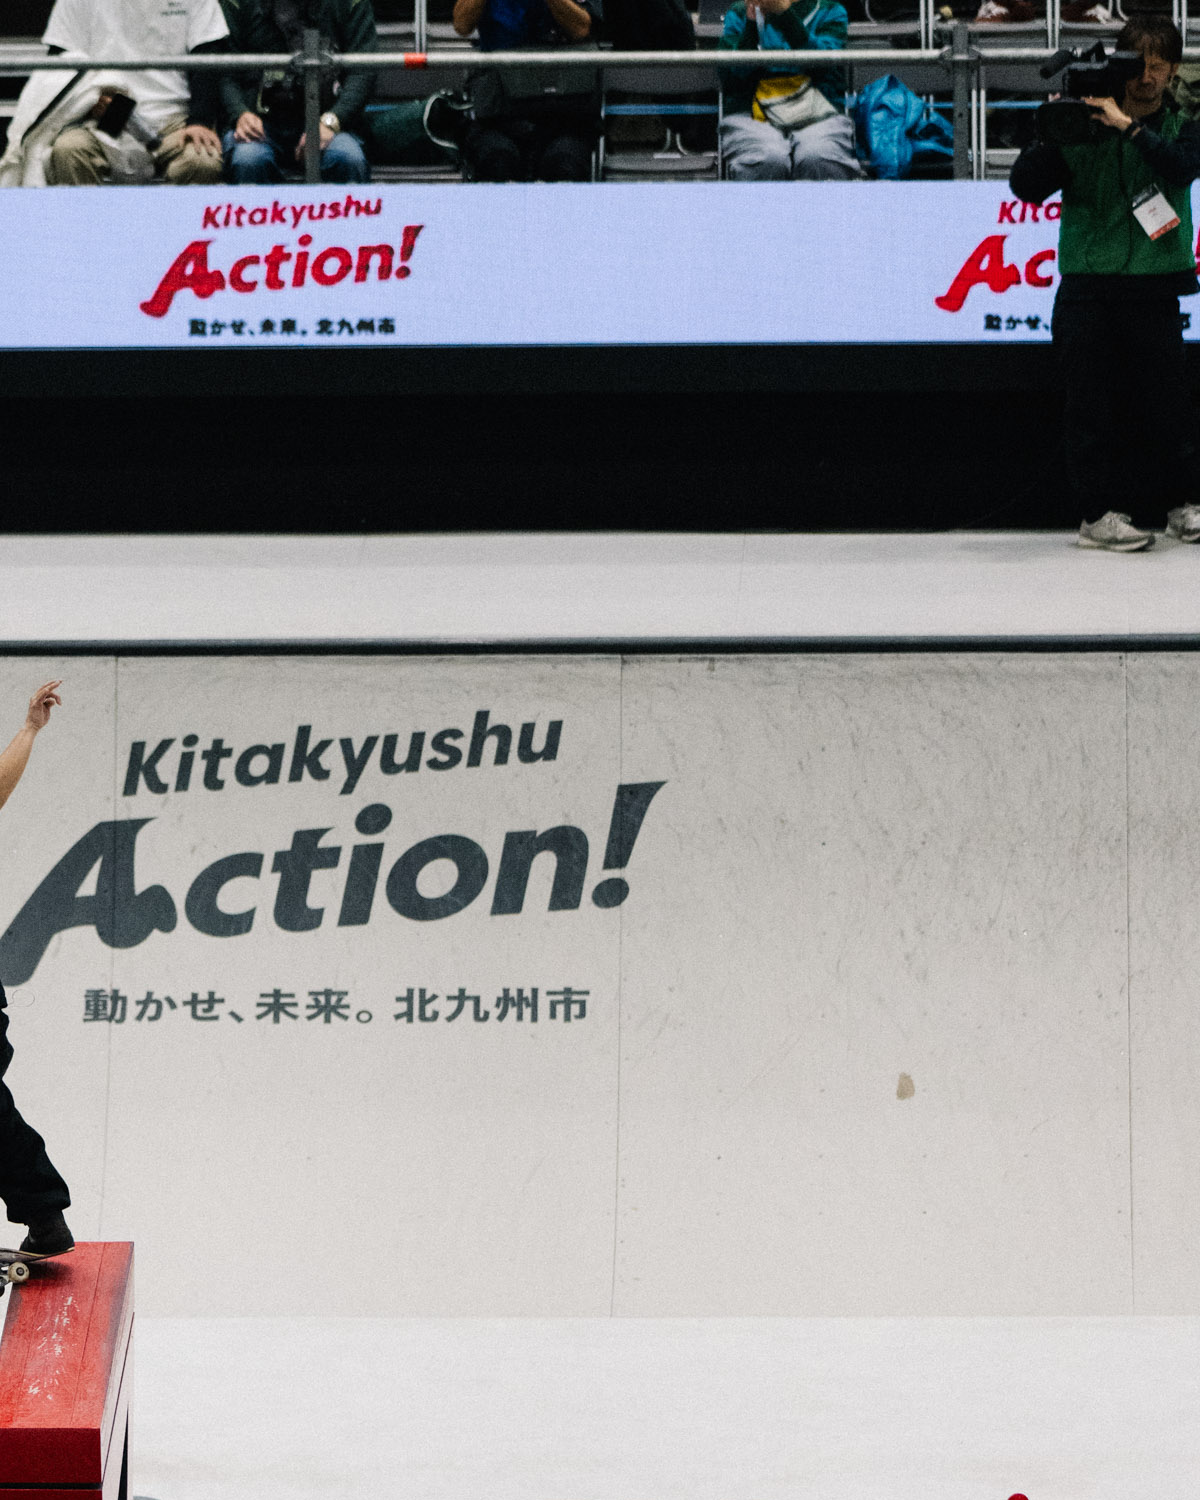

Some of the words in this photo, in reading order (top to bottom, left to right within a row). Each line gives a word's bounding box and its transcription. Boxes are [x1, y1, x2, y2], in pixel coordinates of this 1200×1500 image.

[202, 194, 383, 229] Kitakyushu
[139, 224, 425, 318] Action!
[122, 709, 564, 797] Kitakyushu
[83, 986, 591, 1025] 動かせ、未来。北九州市
